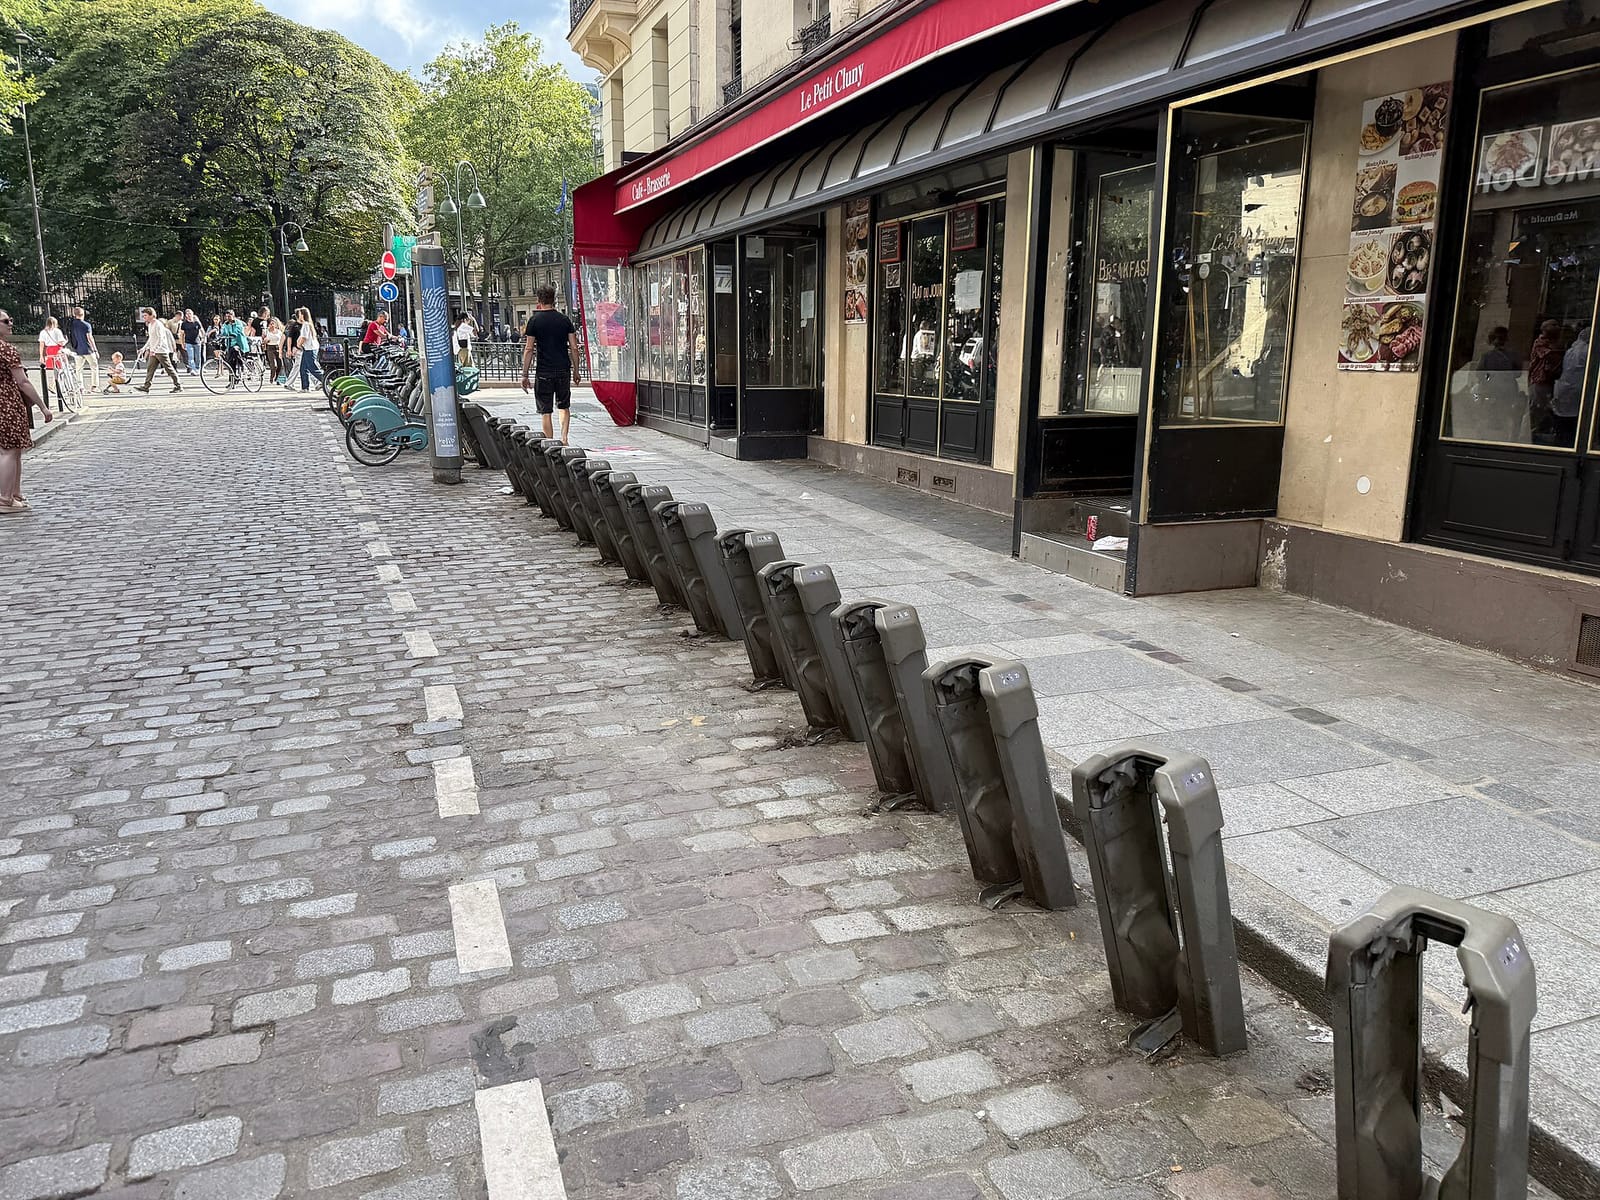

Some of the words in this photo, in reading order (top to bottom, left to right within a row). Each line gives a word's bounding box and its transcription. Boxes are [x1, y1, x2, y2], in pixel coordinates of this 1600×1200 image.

[800, 91, 812, 112] Le
[813, 76, 833, 105] Petit
[835, 63, 864, 93] Cluny
[631, 180, 643, 201] Café
[646, 167, 671, 195] Brasserie
[1098, 258, 1150, 281] BREAKFAST
